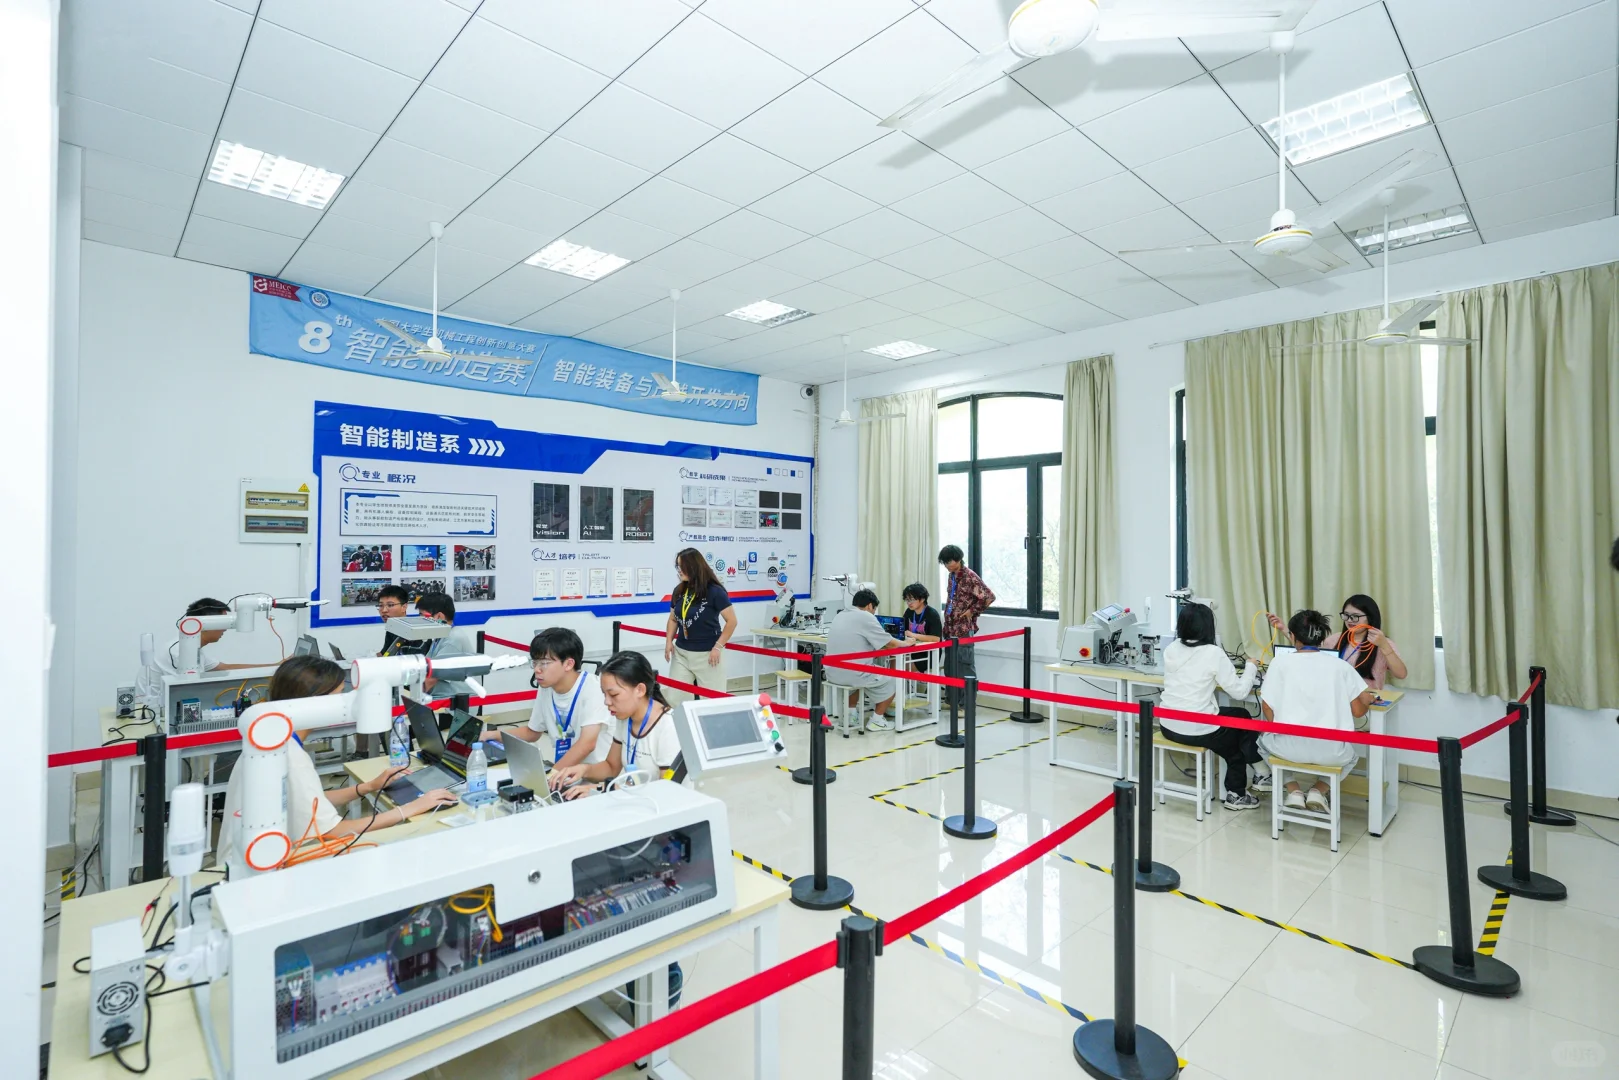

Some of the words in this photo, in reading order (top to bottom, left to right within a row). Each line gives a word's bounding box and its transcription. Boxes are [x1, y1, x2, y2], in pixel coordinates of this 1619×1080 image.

[339, 423, 461, 454] 智能制造系
[361, 470, 381, 480] 专业
[387, 473, 416, 484] 概况
